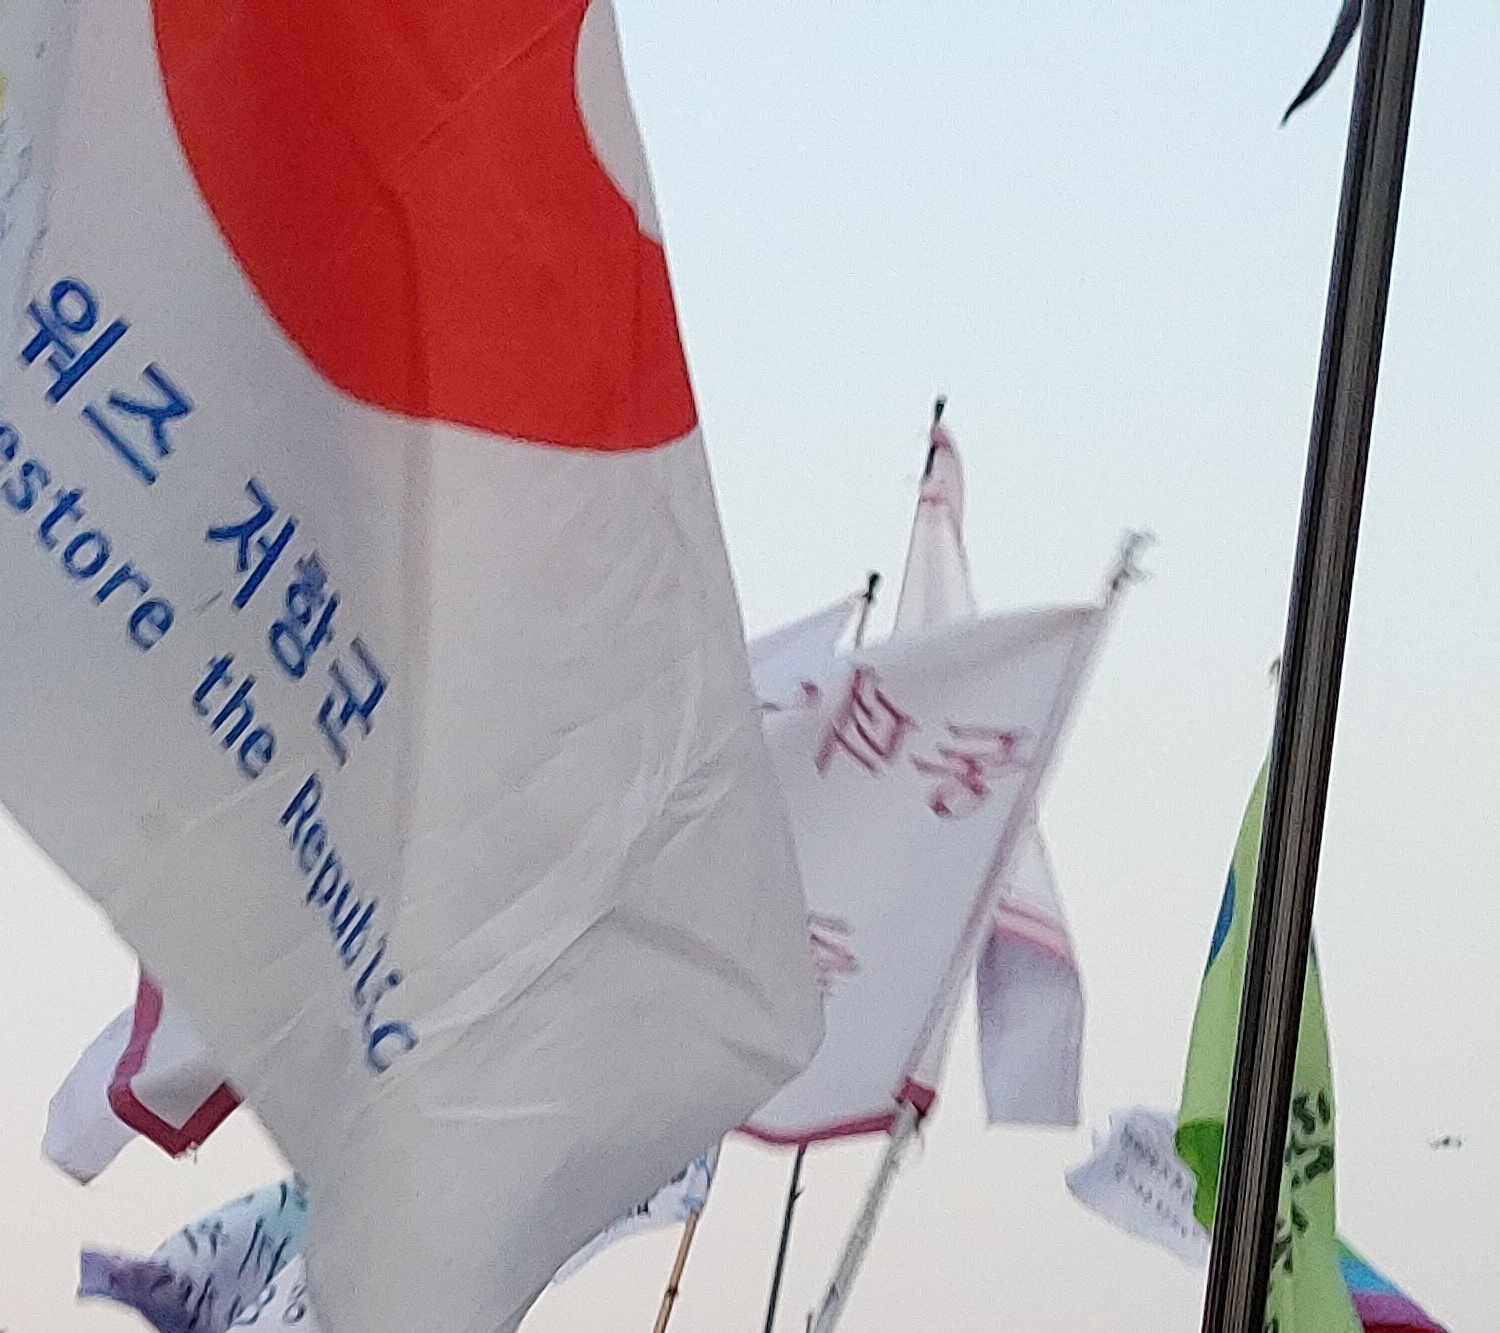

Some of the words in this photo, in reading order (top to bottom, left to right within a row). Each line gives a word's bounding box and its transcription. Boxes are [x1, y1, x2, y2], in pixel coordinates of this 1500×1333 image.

[18, 276, 196, 485] 워즈
[205, 478, 389, 768] 저항군
[191, 652, 279, 781] the
